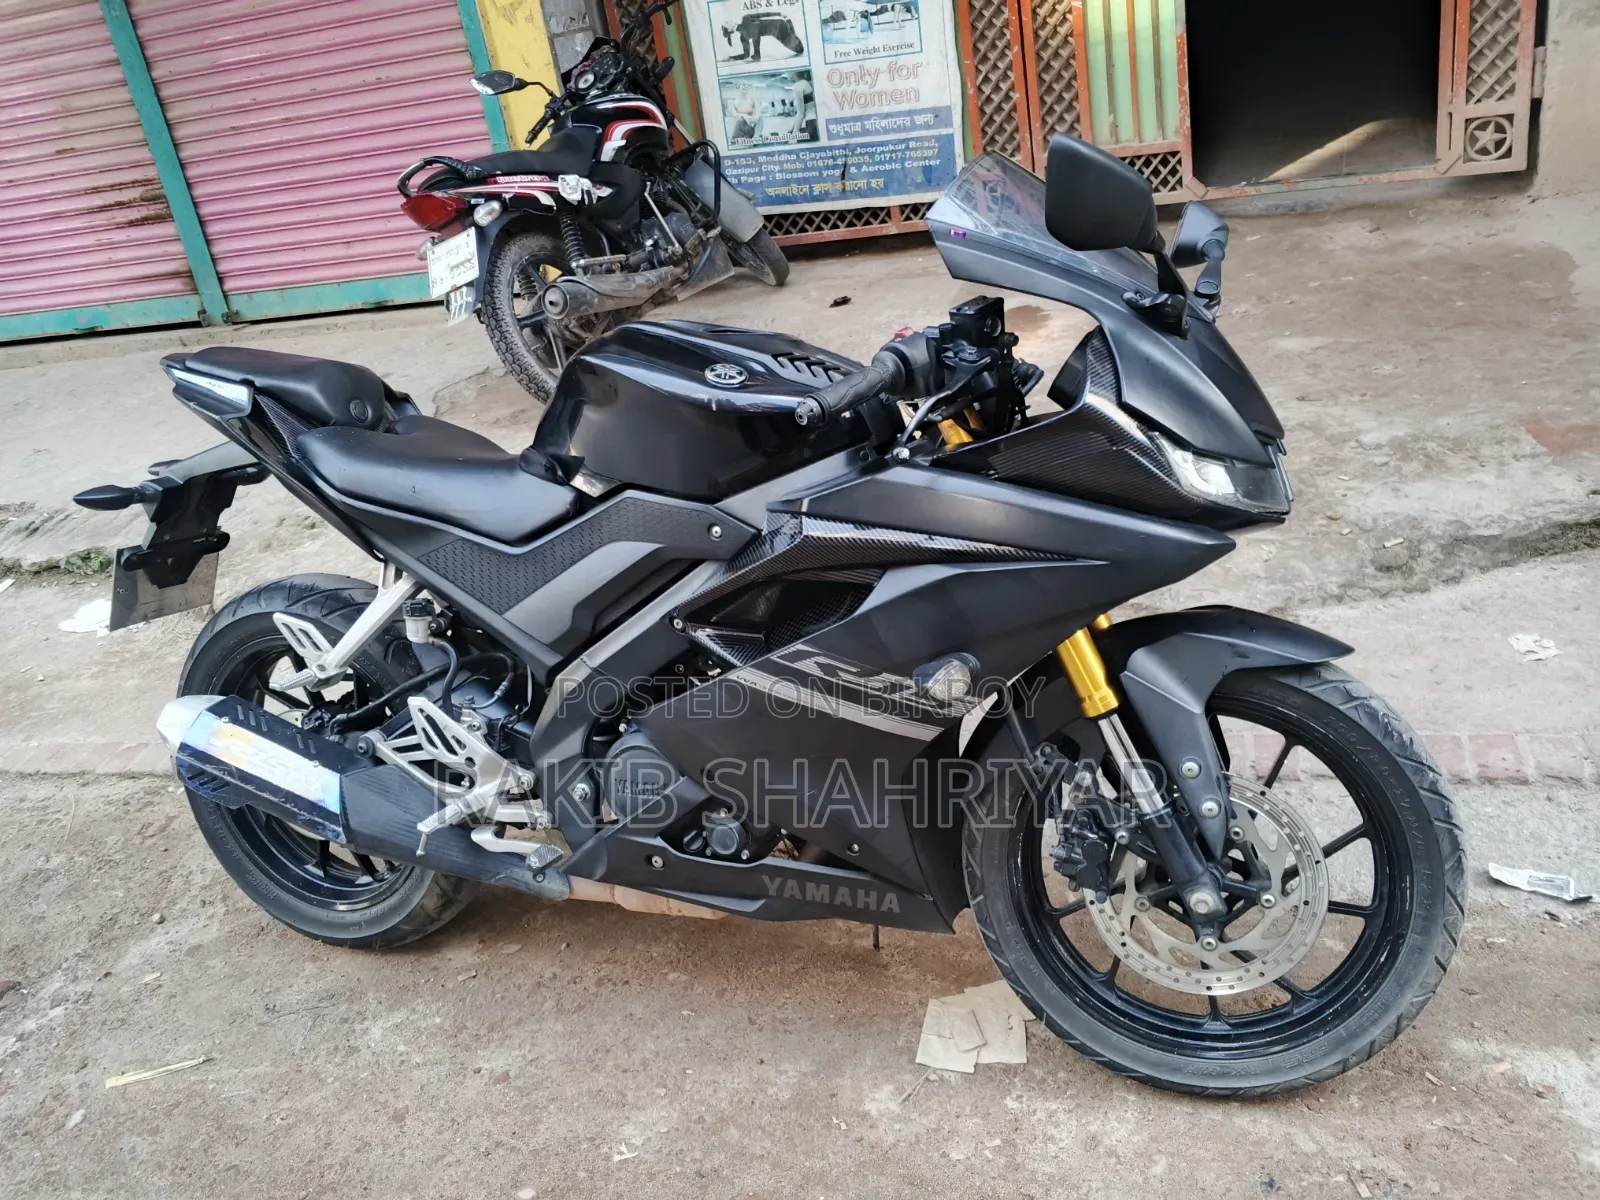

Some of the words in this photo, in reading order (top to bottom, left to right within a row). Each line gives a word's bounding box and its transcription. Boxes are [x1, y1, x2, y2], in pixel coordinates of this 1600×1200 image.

[742, 1, 762, 10] ABS
[765, 0, 773, 8] &
[834, 50, 852, 59] Free
[853, 47, 881, 56] Weight
[882, 42, 915, 53] Exercise
[826, 65, 880, 89] Only
[887, 61, 923, 81] for
[832, 87, 921, 111] Women
[736, 136, 761, 146] Fitness
[854, 143, 906, 155] Joorpukur
[908, 139, 939, 149] Road,
[725, 167, 760, 176] Gazipur
[783, 161, 805, 170] Mob:
[740, 175, 767, 184] Page
[775, 170, 819, 180] Blossom
[822, 168, 845, 177] yog
[861, 163, 902, 173] Aerobic
[904, 159, 942, 168] Center
[761, 874, 901, 914] YAMAHA
